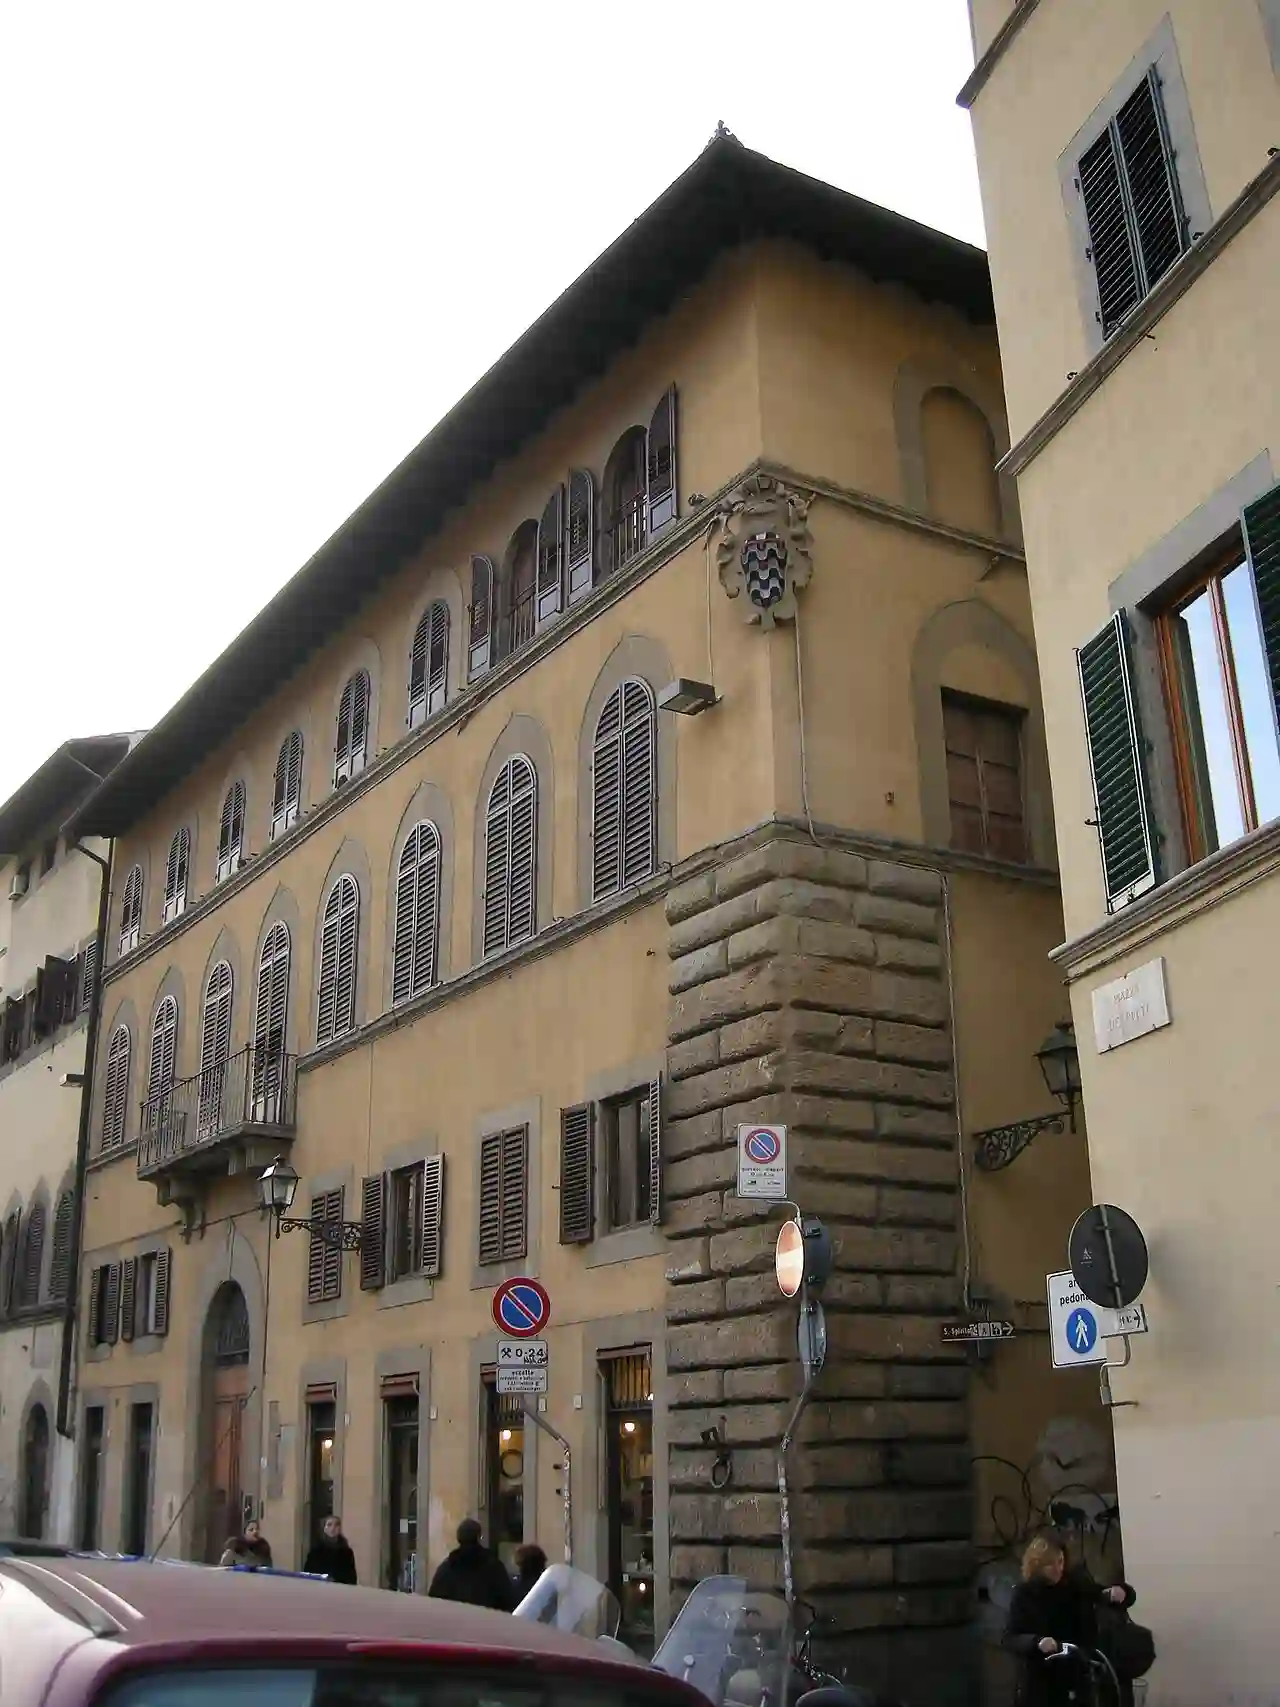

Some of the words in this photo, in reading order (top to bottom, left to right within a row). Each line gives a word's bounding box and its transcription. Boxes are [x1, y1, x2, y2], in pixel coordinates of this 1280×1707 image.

[1068, 1279, 1077, 1288] ar
[1059, 1292, 1089, 1306] pedon
[515, 1348, 544, 1357] 0-24
